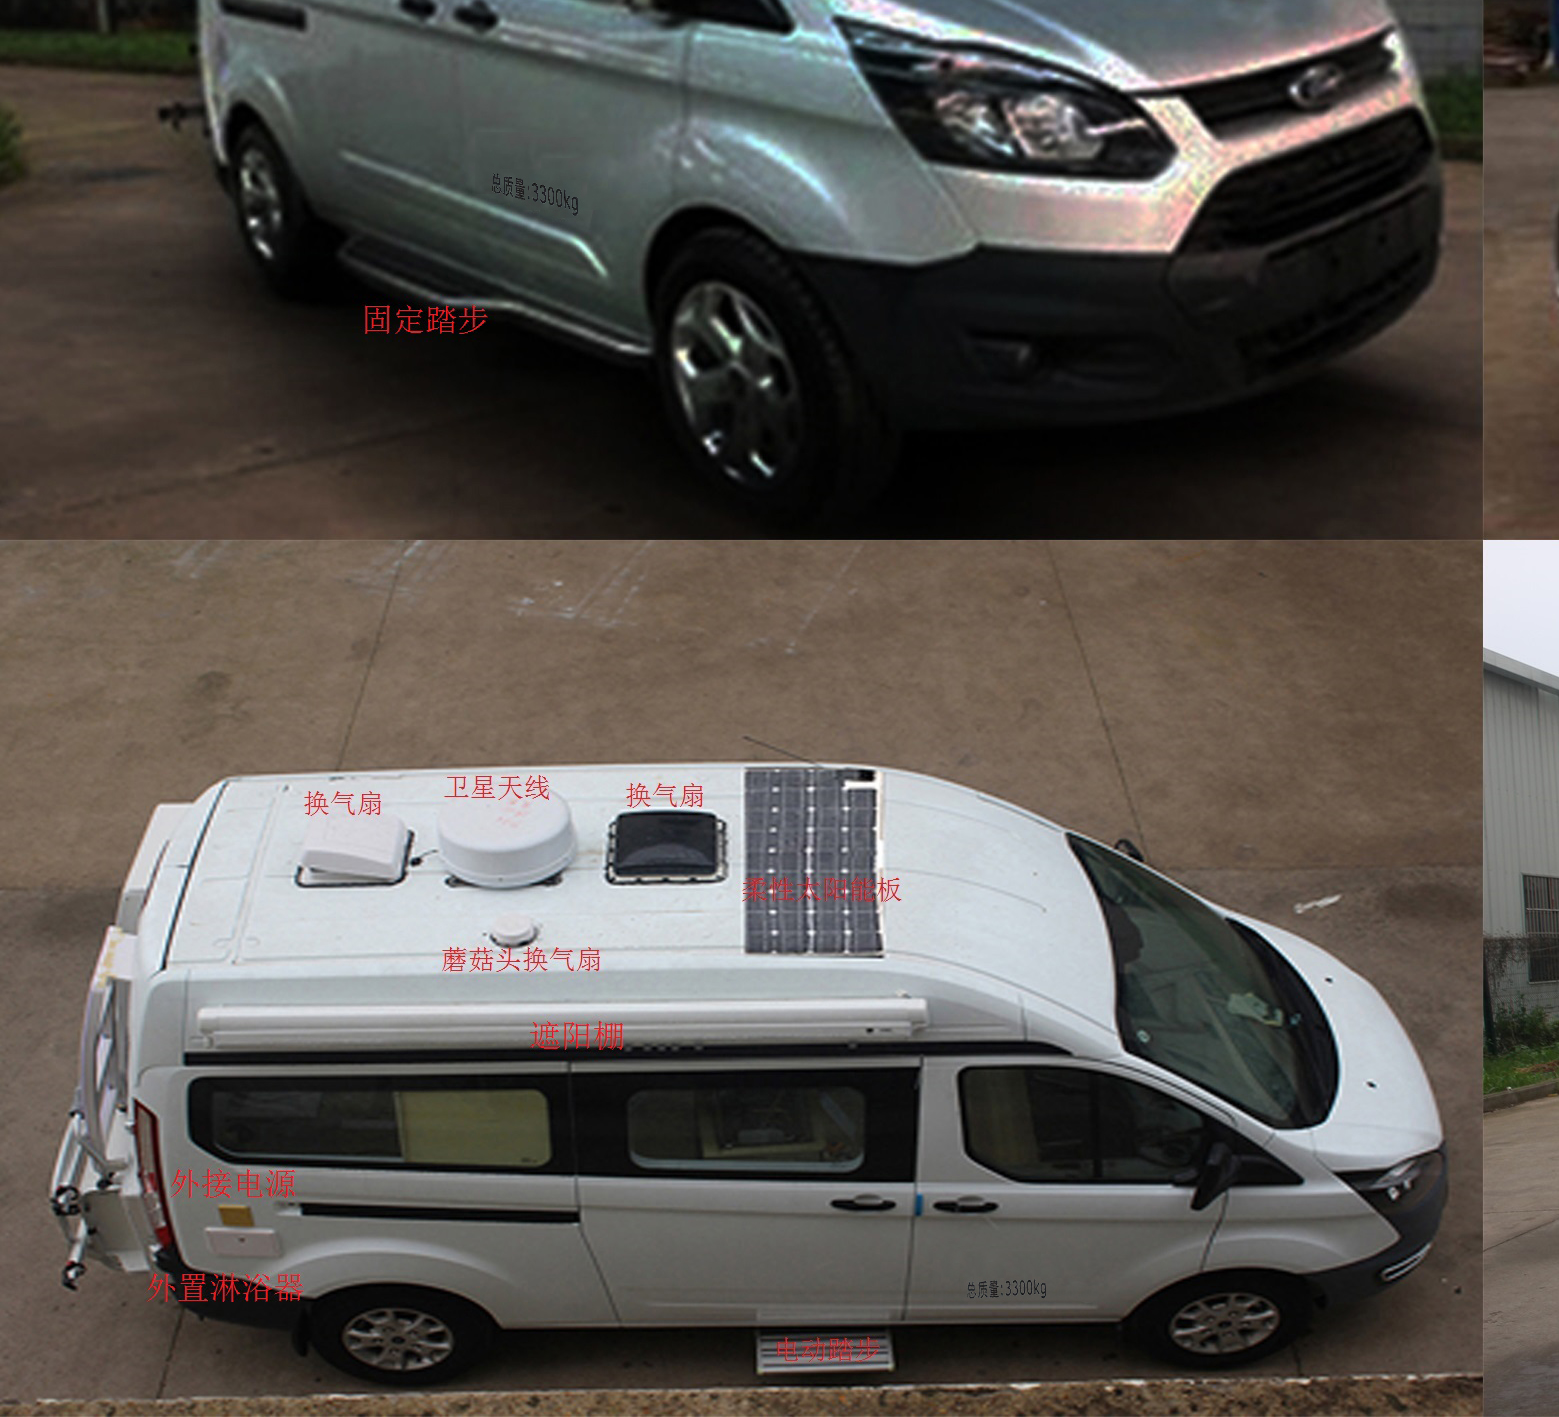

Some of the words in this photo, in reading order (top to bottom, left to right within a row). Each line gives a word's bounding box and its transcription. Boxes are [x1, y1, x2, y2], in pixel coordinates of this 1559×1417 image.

[491, 173, 579, 216] 总质量:3300kg
[966, 1279, 1047, 1299] 总质量:3300kg
